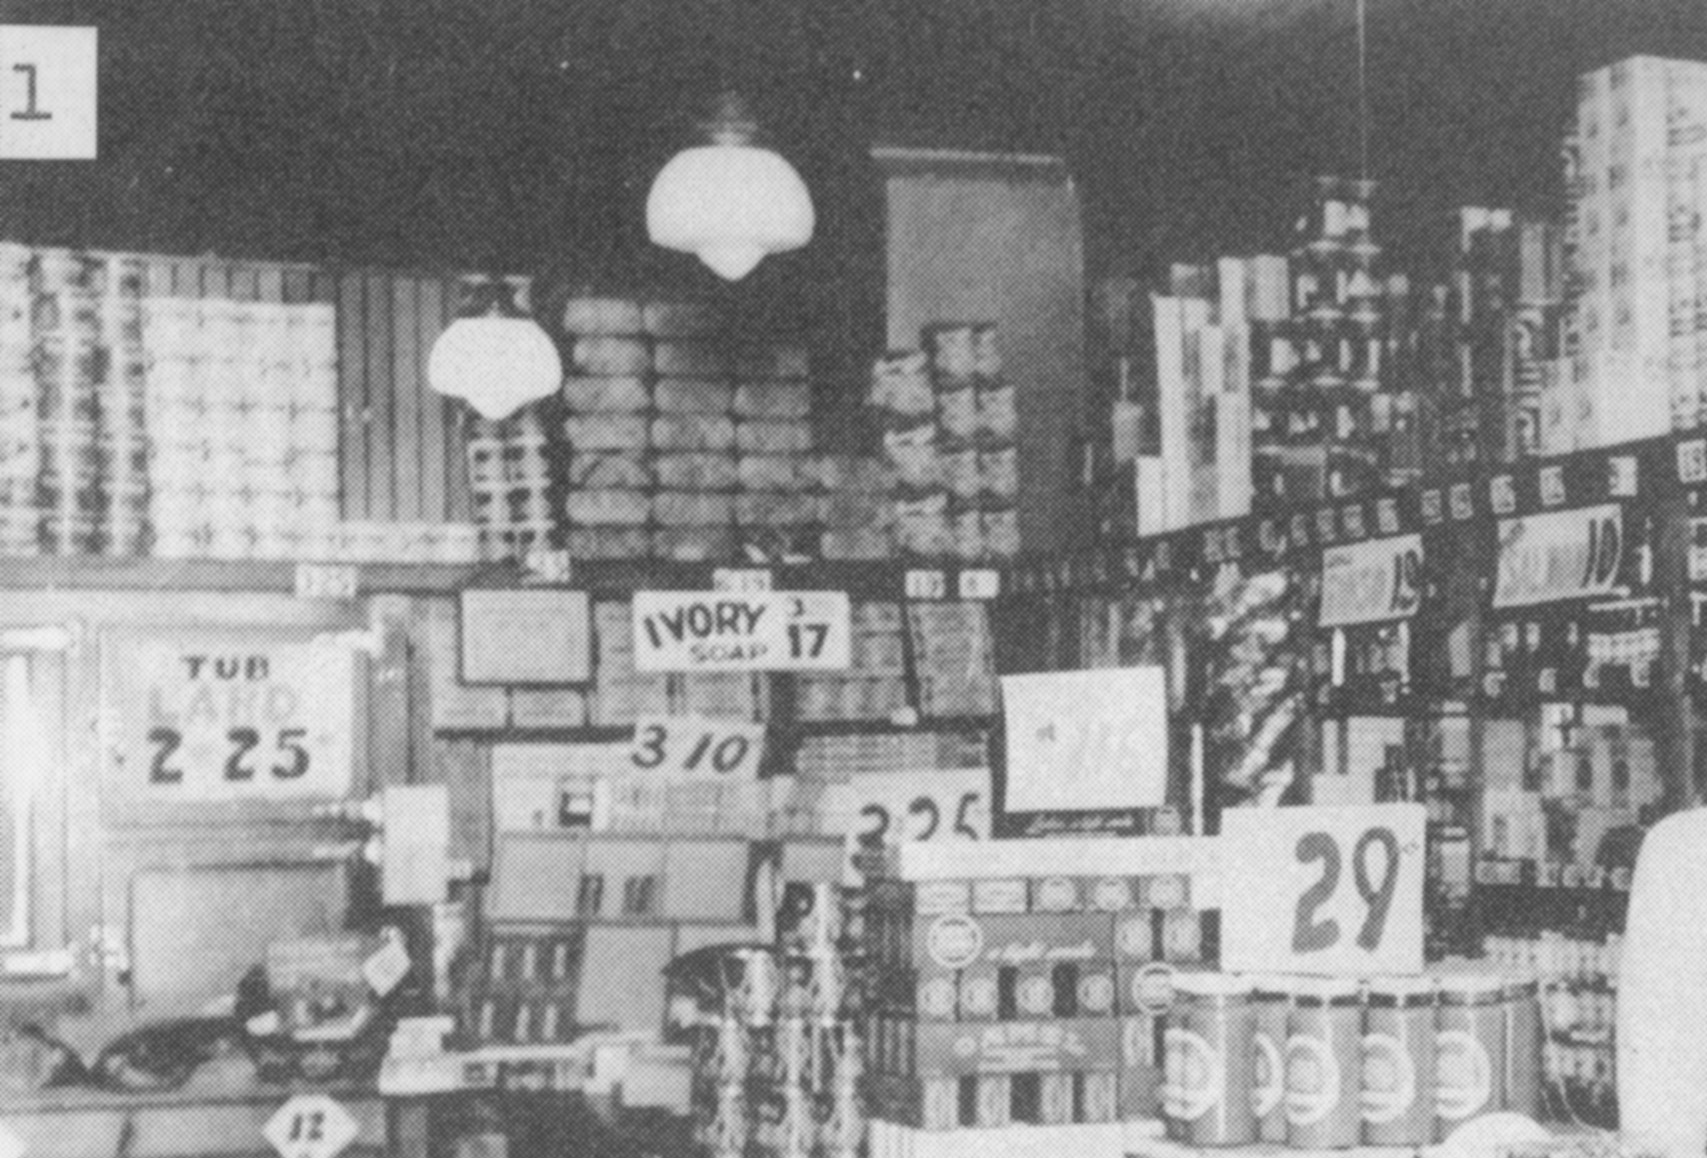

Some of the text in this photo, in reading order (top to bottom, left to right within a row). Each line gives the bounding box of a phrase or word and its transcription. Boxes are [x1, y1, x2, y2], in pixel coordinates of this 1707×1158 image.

[642, 599, 767, 650] IVORY
[689, 622, 831, 665] SOAP 17
[181, 654, 270, 682] TUB
[146, 725, 312, 784] 2 25
[630, 724, 751, 774] 3 10
[1291, 826, 1401, 957] 29
